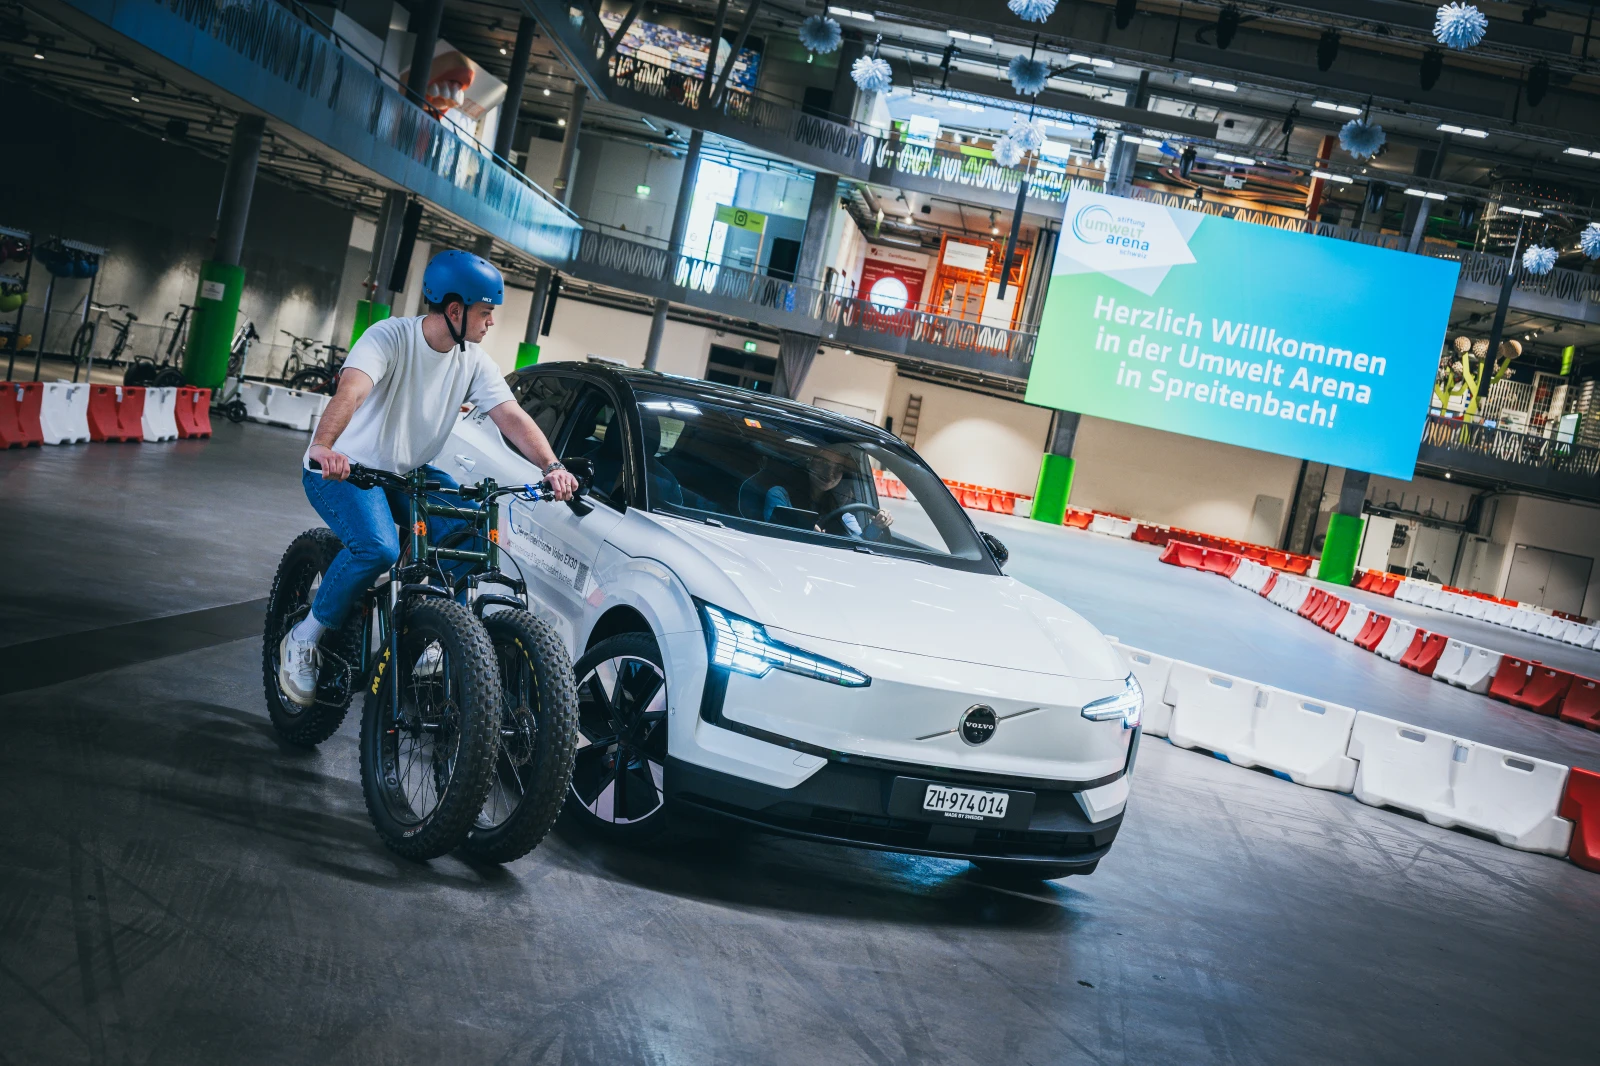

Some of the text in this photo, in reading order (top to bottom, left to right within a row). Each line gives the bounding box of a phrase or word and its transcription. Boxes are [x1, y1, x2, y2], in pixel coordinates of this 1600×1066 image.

[1117, 216, 1146, 228] stiftung
[1106, 234, 1150, 251] arena
[1119, 249, 1147, 259] schweiz
[1093, 295, 1387, 376] Herzlich Willkommen
[1095, 326, 1372, 404] in der Umwelt Arena
[1116, 361, 1338, 429] in Spreitenbach!
[563, 553, 578, 570] EX30
[965, 721, 994, 730] VOLVO
[944, 811, 958, 819] MADE
